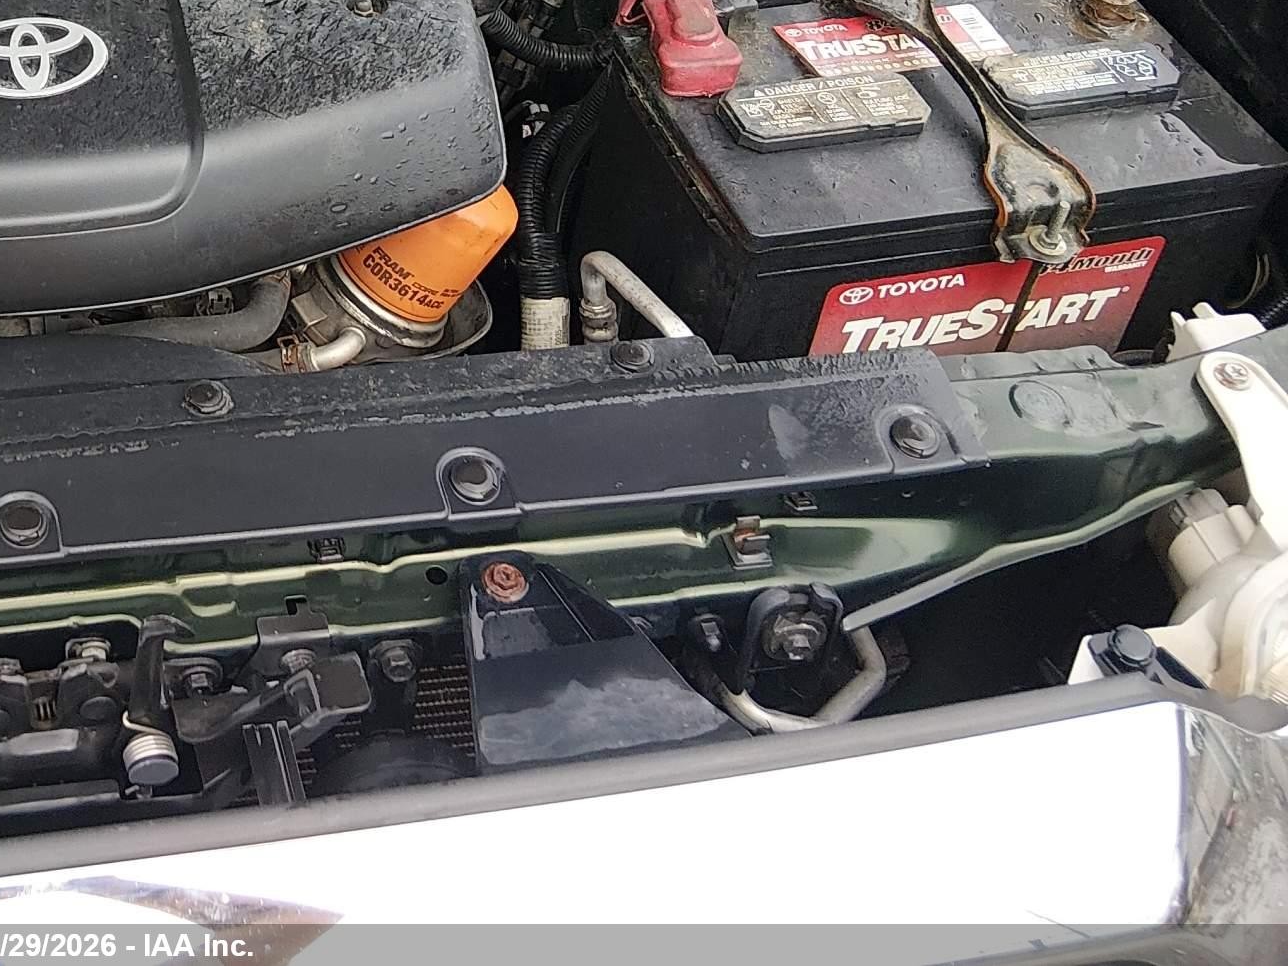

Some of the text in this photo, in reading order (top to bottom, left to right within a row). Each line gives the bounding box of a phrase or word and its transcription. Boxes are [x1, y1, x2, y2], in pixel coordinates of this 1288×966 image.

[803, 23, 848, 34] TOYOTA
[764, 81, 817, 96] DANGER
[826, 75, 875, 88] POISON
[372, 246, 410, 280] FRAM
[878, 273, 966, 299] TOYOTA
